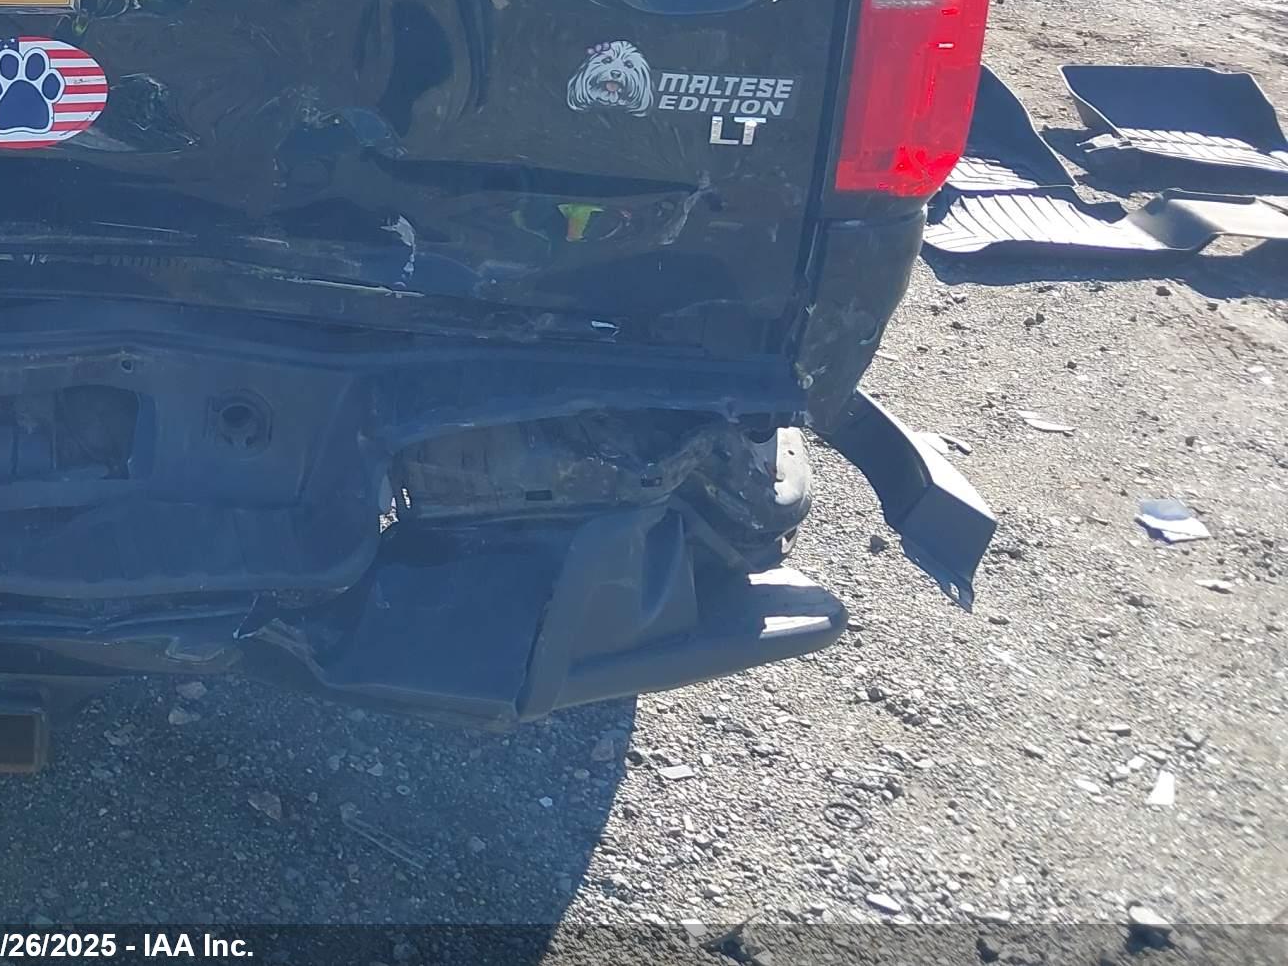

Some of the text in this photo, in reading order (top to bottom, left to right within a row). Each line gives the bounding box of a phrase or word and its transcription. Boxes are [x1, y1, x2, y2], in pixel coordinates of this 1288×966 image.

[658, 72, 794, 99] MALTESE
[658, 96, 784, 117] EDITION
[709, 116, 767, 145] LT
